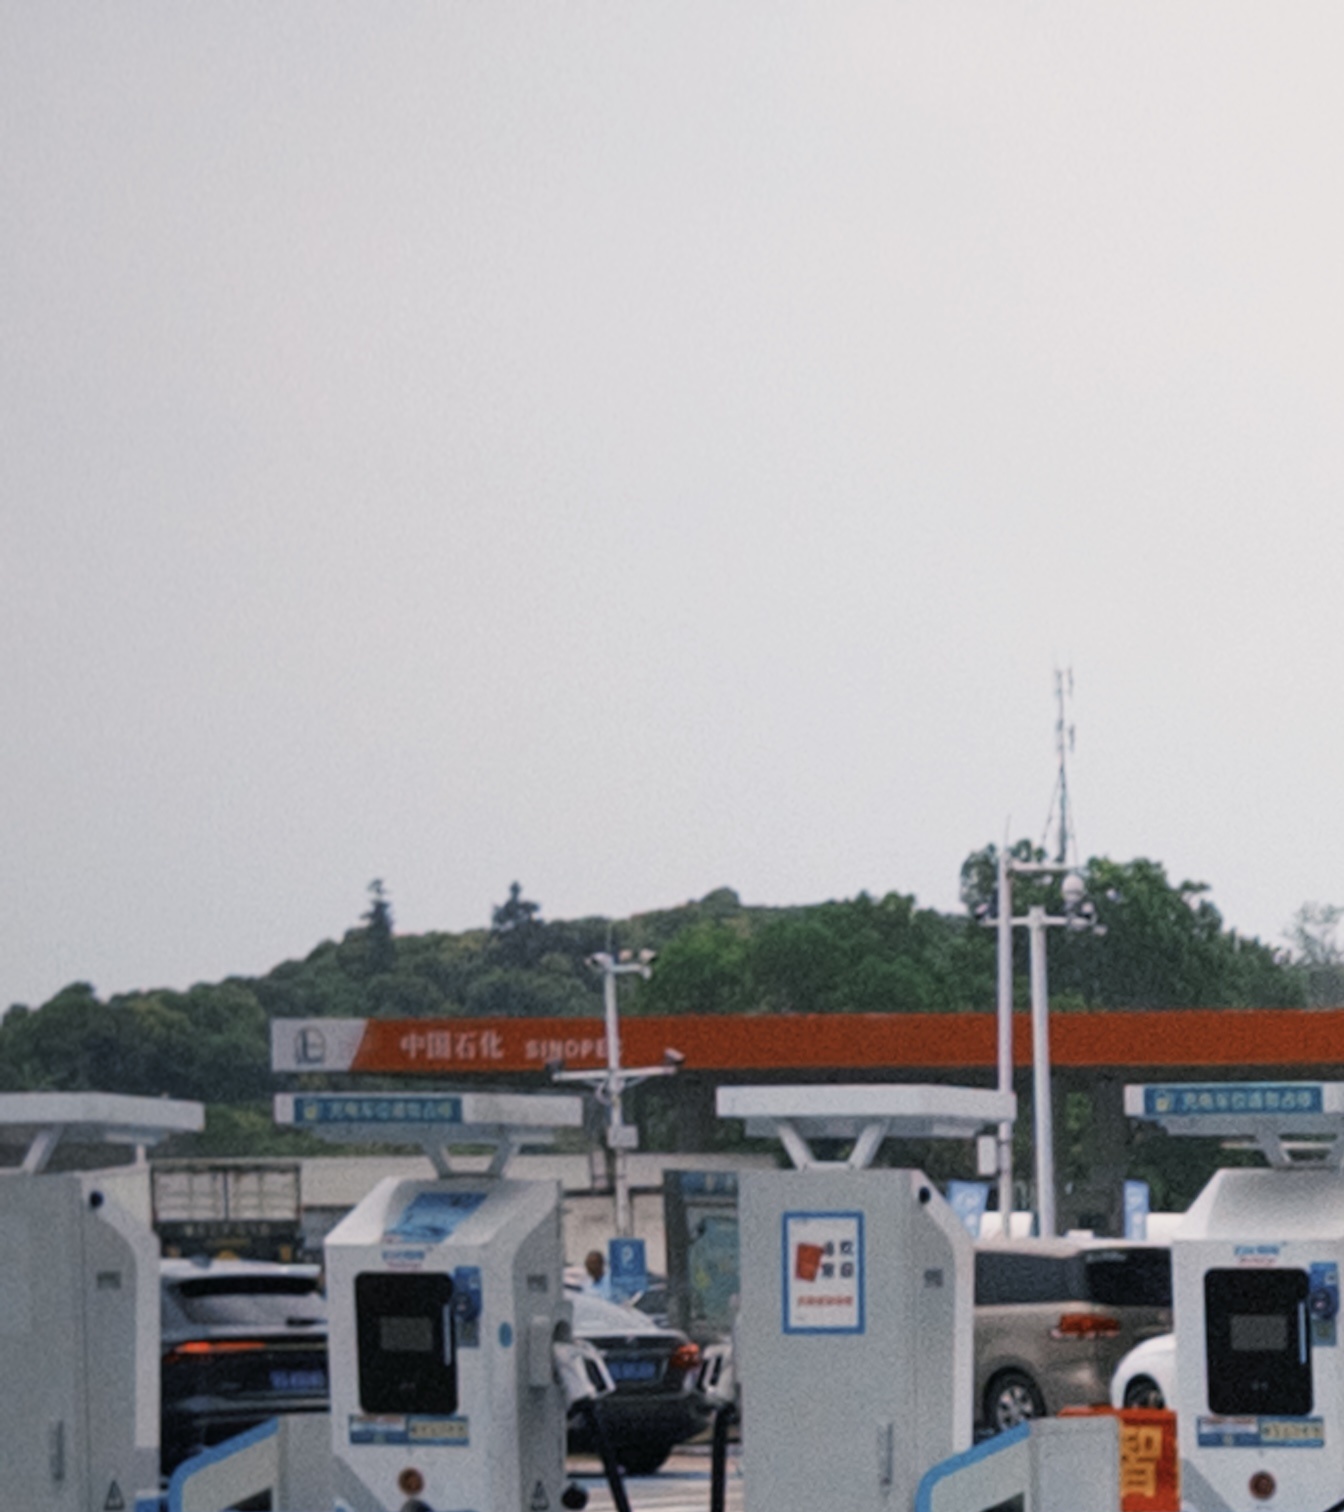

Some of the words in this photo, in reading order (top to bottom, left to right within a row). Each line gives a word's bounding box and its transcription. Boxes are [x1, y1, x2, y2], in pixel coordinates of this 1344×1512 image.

[401, 1030, 505, 1060] 中国石化
[525, 1038, 622, 1059] SINOPE
